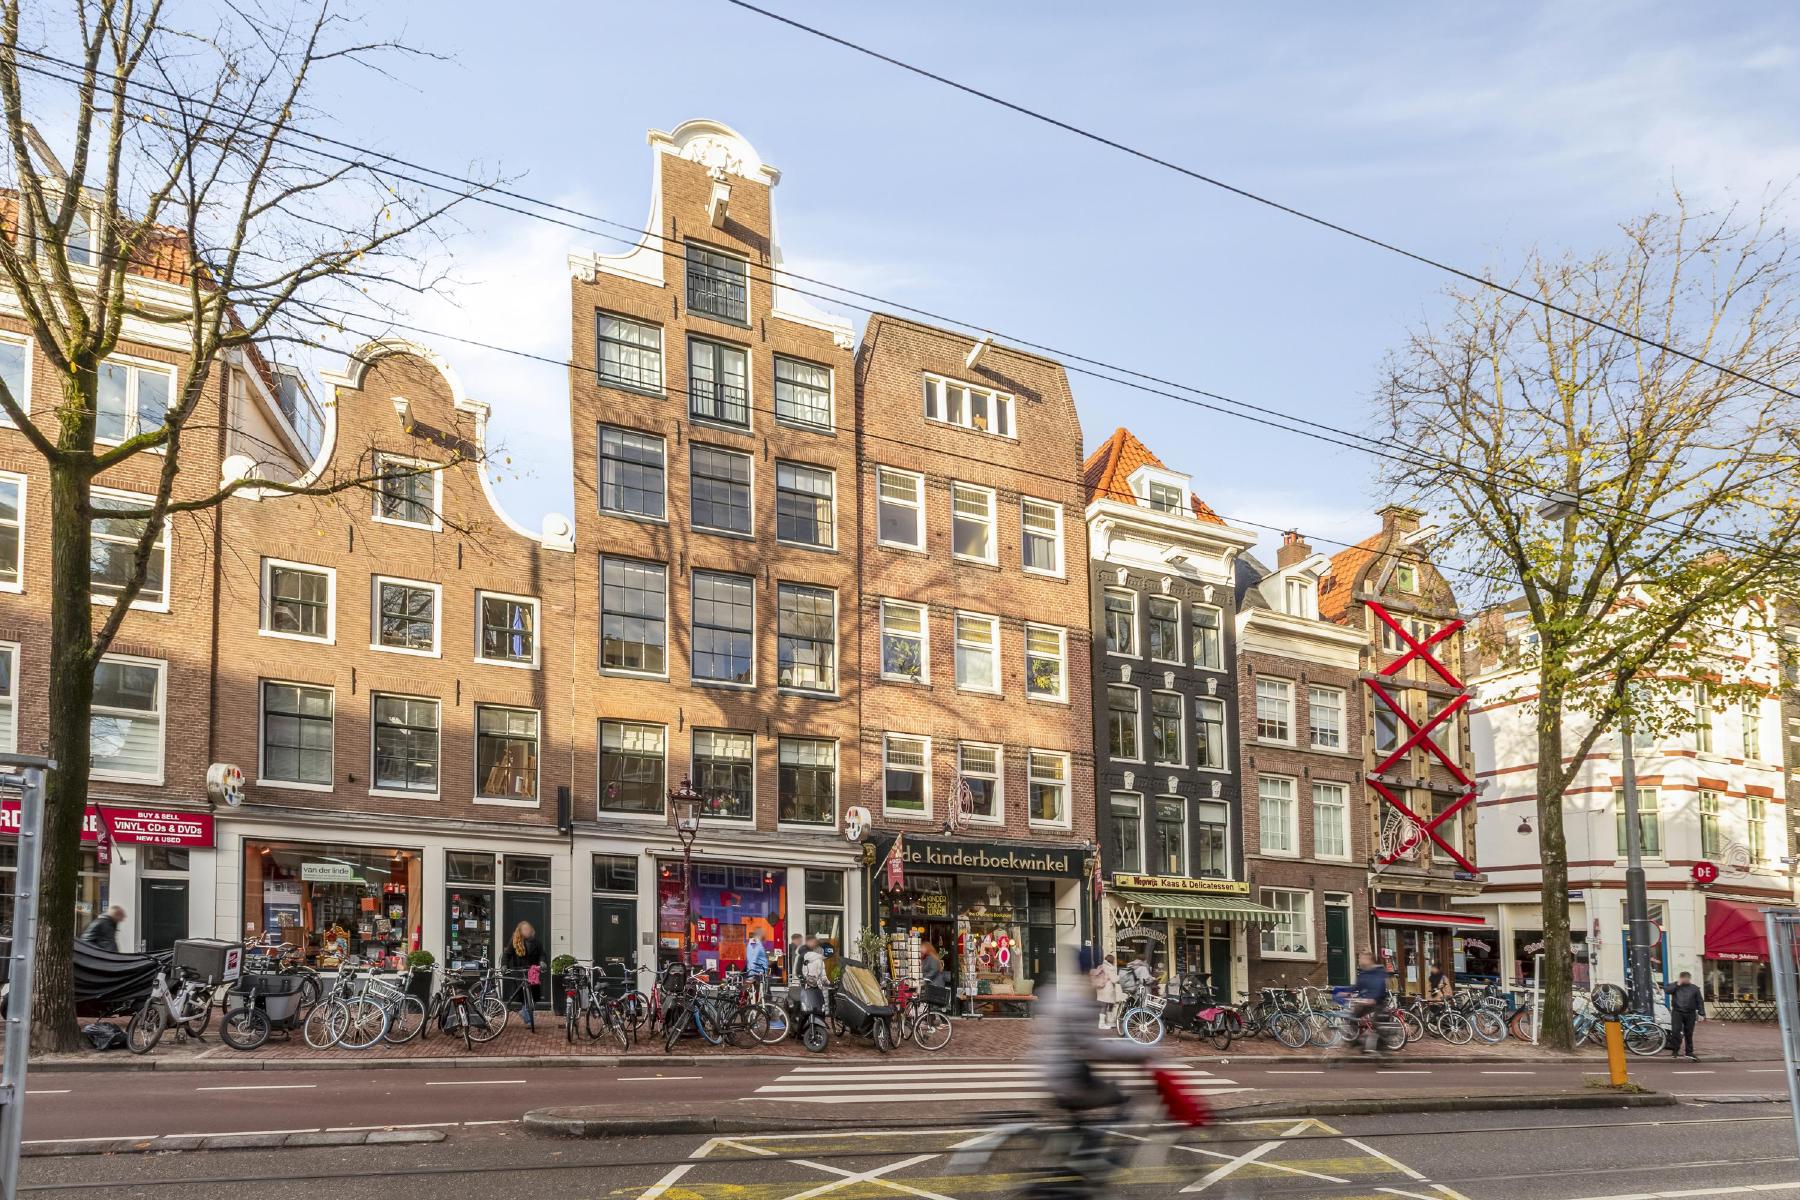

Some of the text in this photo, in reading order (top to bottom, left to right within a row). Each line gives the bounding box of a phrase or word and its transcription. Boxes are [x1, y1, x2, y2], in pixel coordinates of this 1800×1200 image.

[114, 821, 145, 833] VINYL,
[147, 824, 167, 832] CDs
[177, 825, 202, 834] DVDs
[902, 845, 922, 863] de
[926, 846, 1068, 872] kinderboekwinkel
[1161, 879, 1180, 888] Kaas
[1181, 880, 1187, 888] &
[1189, 880, 1235, 890] Delicatessen
